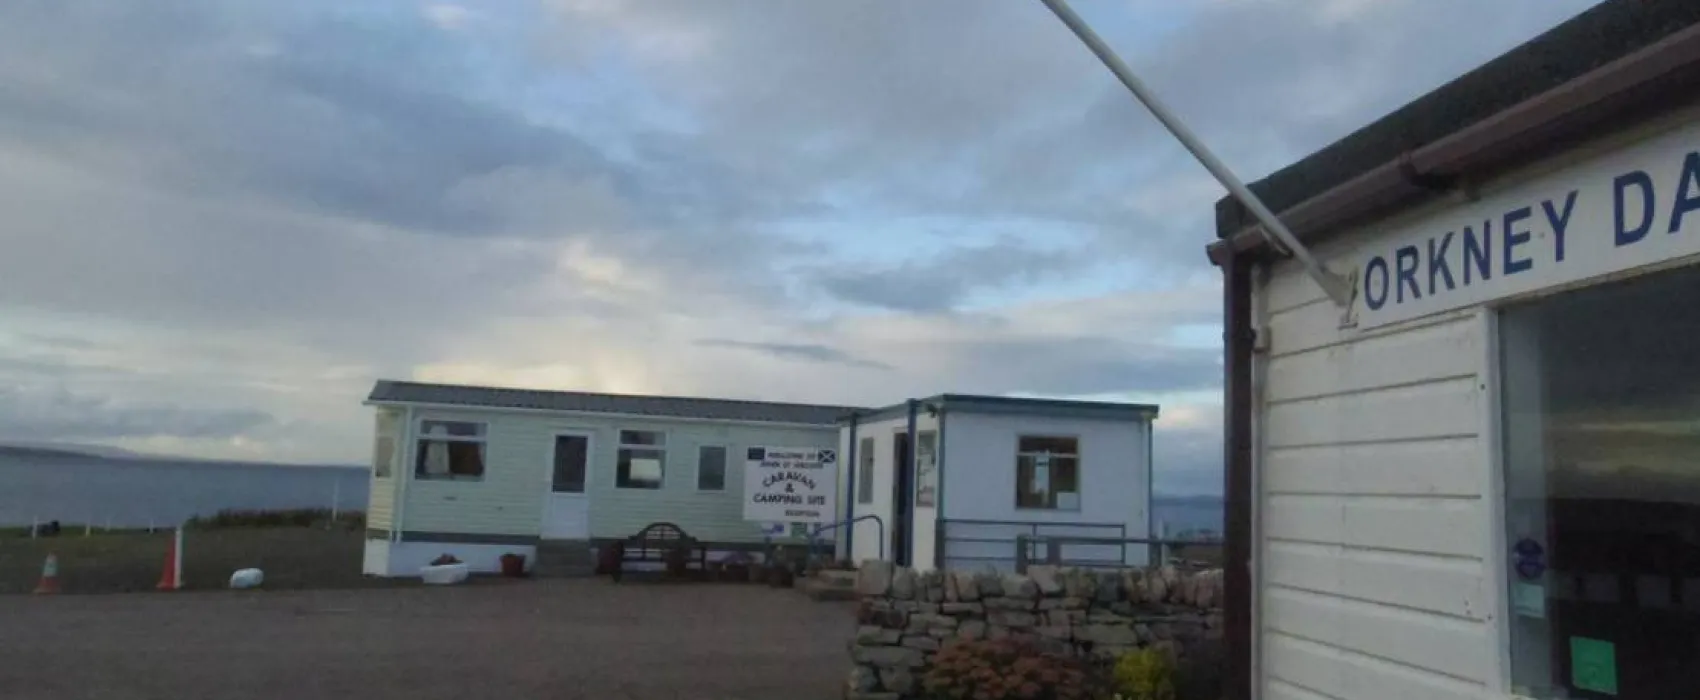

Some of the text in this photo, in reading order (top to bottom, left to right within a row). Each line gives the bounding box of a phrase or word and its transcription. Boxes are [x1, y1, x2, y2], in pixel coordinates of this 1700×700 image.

[1364, 151, 1700, 311] ORKNEY DA
[762, 471, 816, 490] CARAVAN
[785, 483, 794, 493] &
[753, 494, 802, 505] CAMPING
